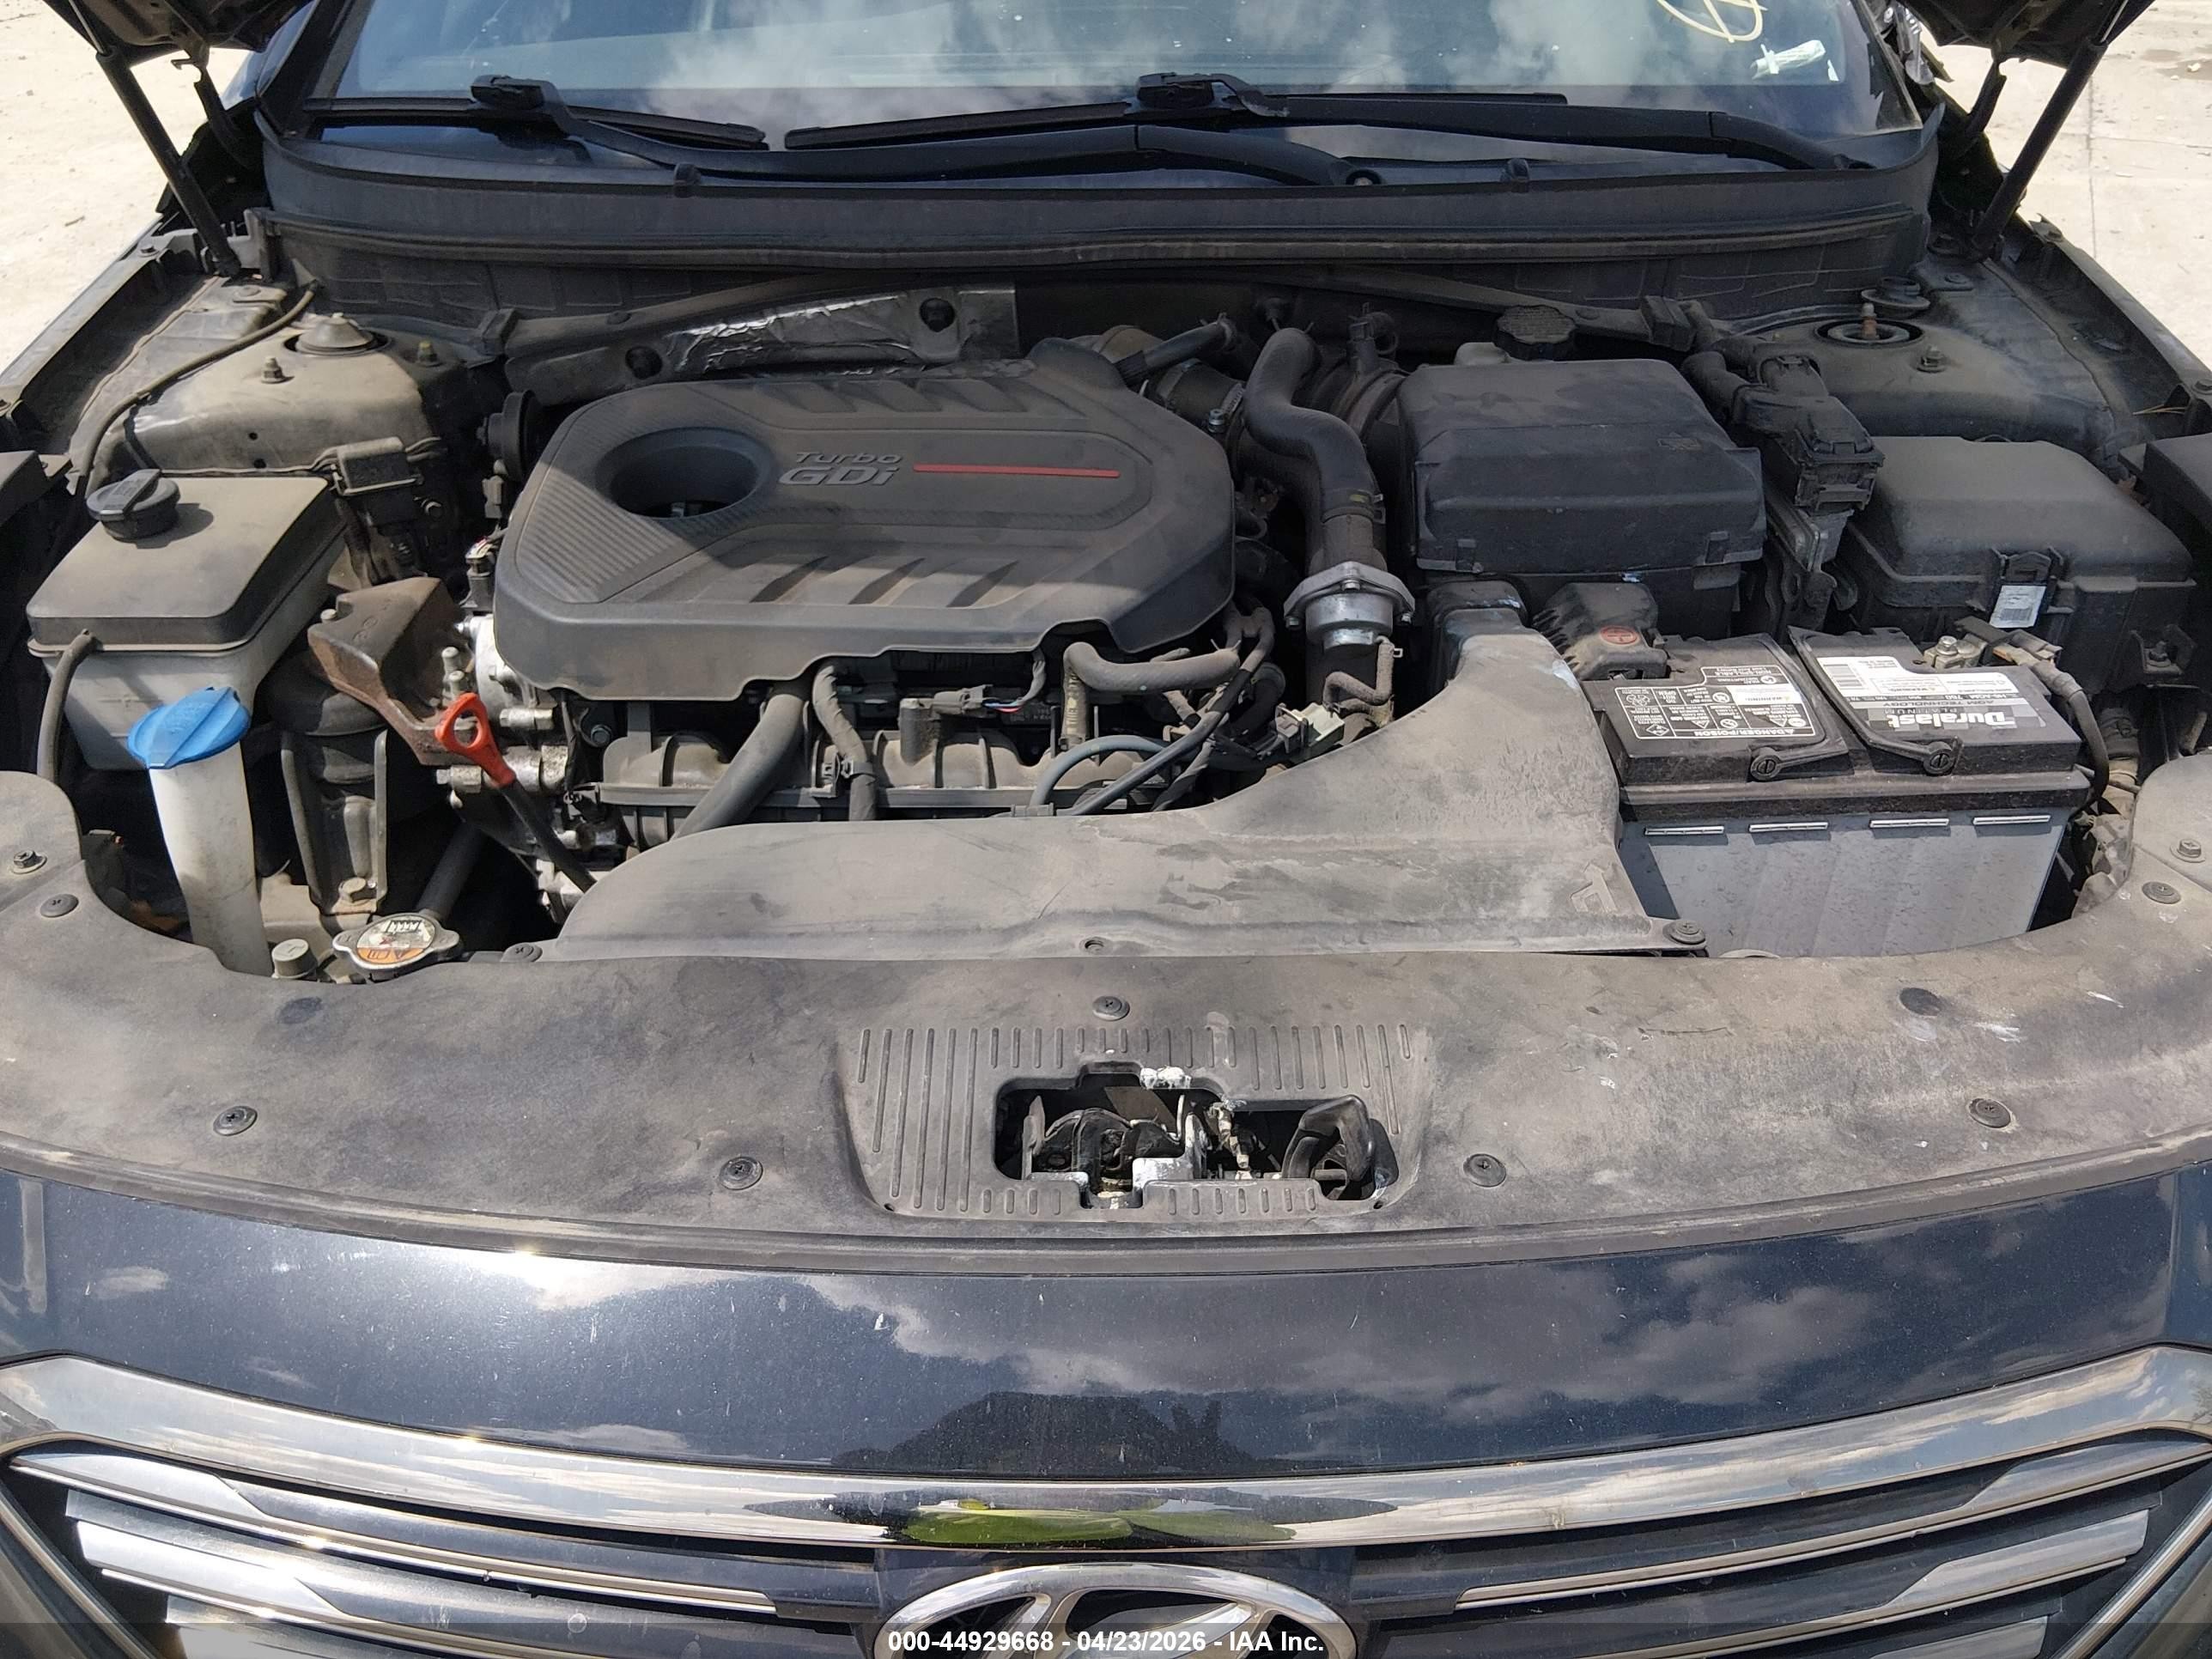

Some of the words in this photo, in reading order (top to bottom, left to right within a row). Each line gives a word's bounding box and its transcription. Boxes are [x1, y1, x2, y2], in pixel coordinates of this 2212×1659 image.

[797, 452, 902, 465] Turbo
[779, 466, 899, 486] GDi
[1887, 712, 2015, 727] Duralast
